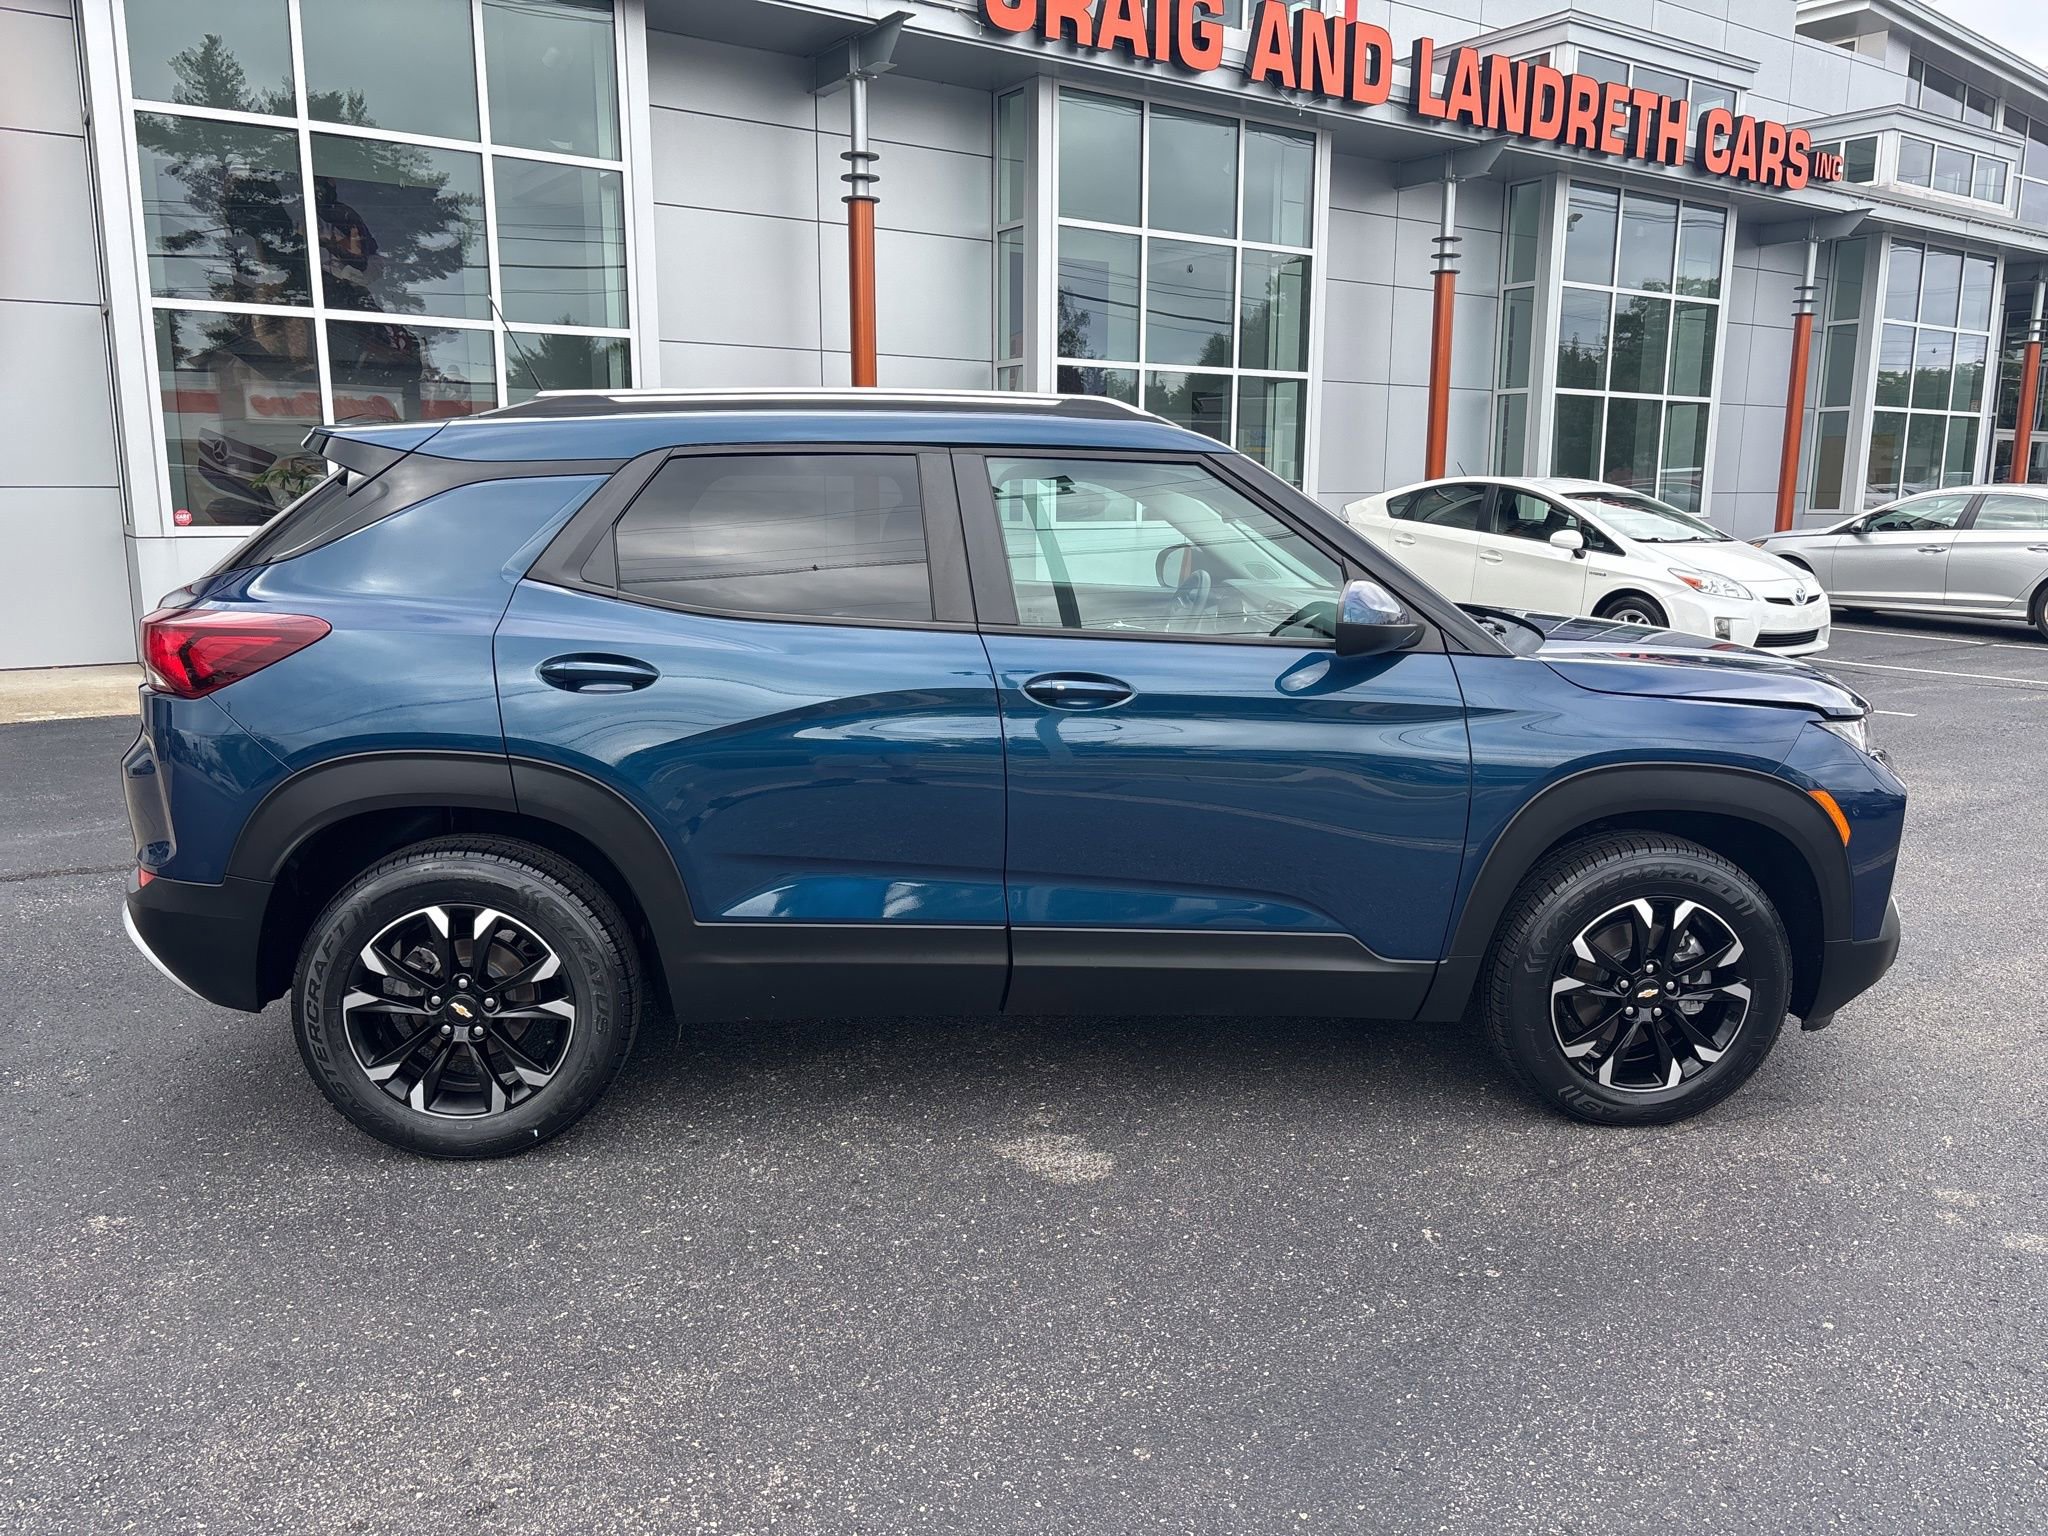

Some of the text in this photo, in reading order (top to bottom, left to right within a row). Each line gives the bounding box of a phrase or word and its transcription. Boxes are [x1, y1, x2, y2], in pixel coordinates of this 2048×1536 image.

[1250, 0, 1394, 106] AND
[1416, 36, 1689, 167] LANDRETH
[1704, 107, 1812, 191] CARS
[1814, 151, 1844, 182] INC
